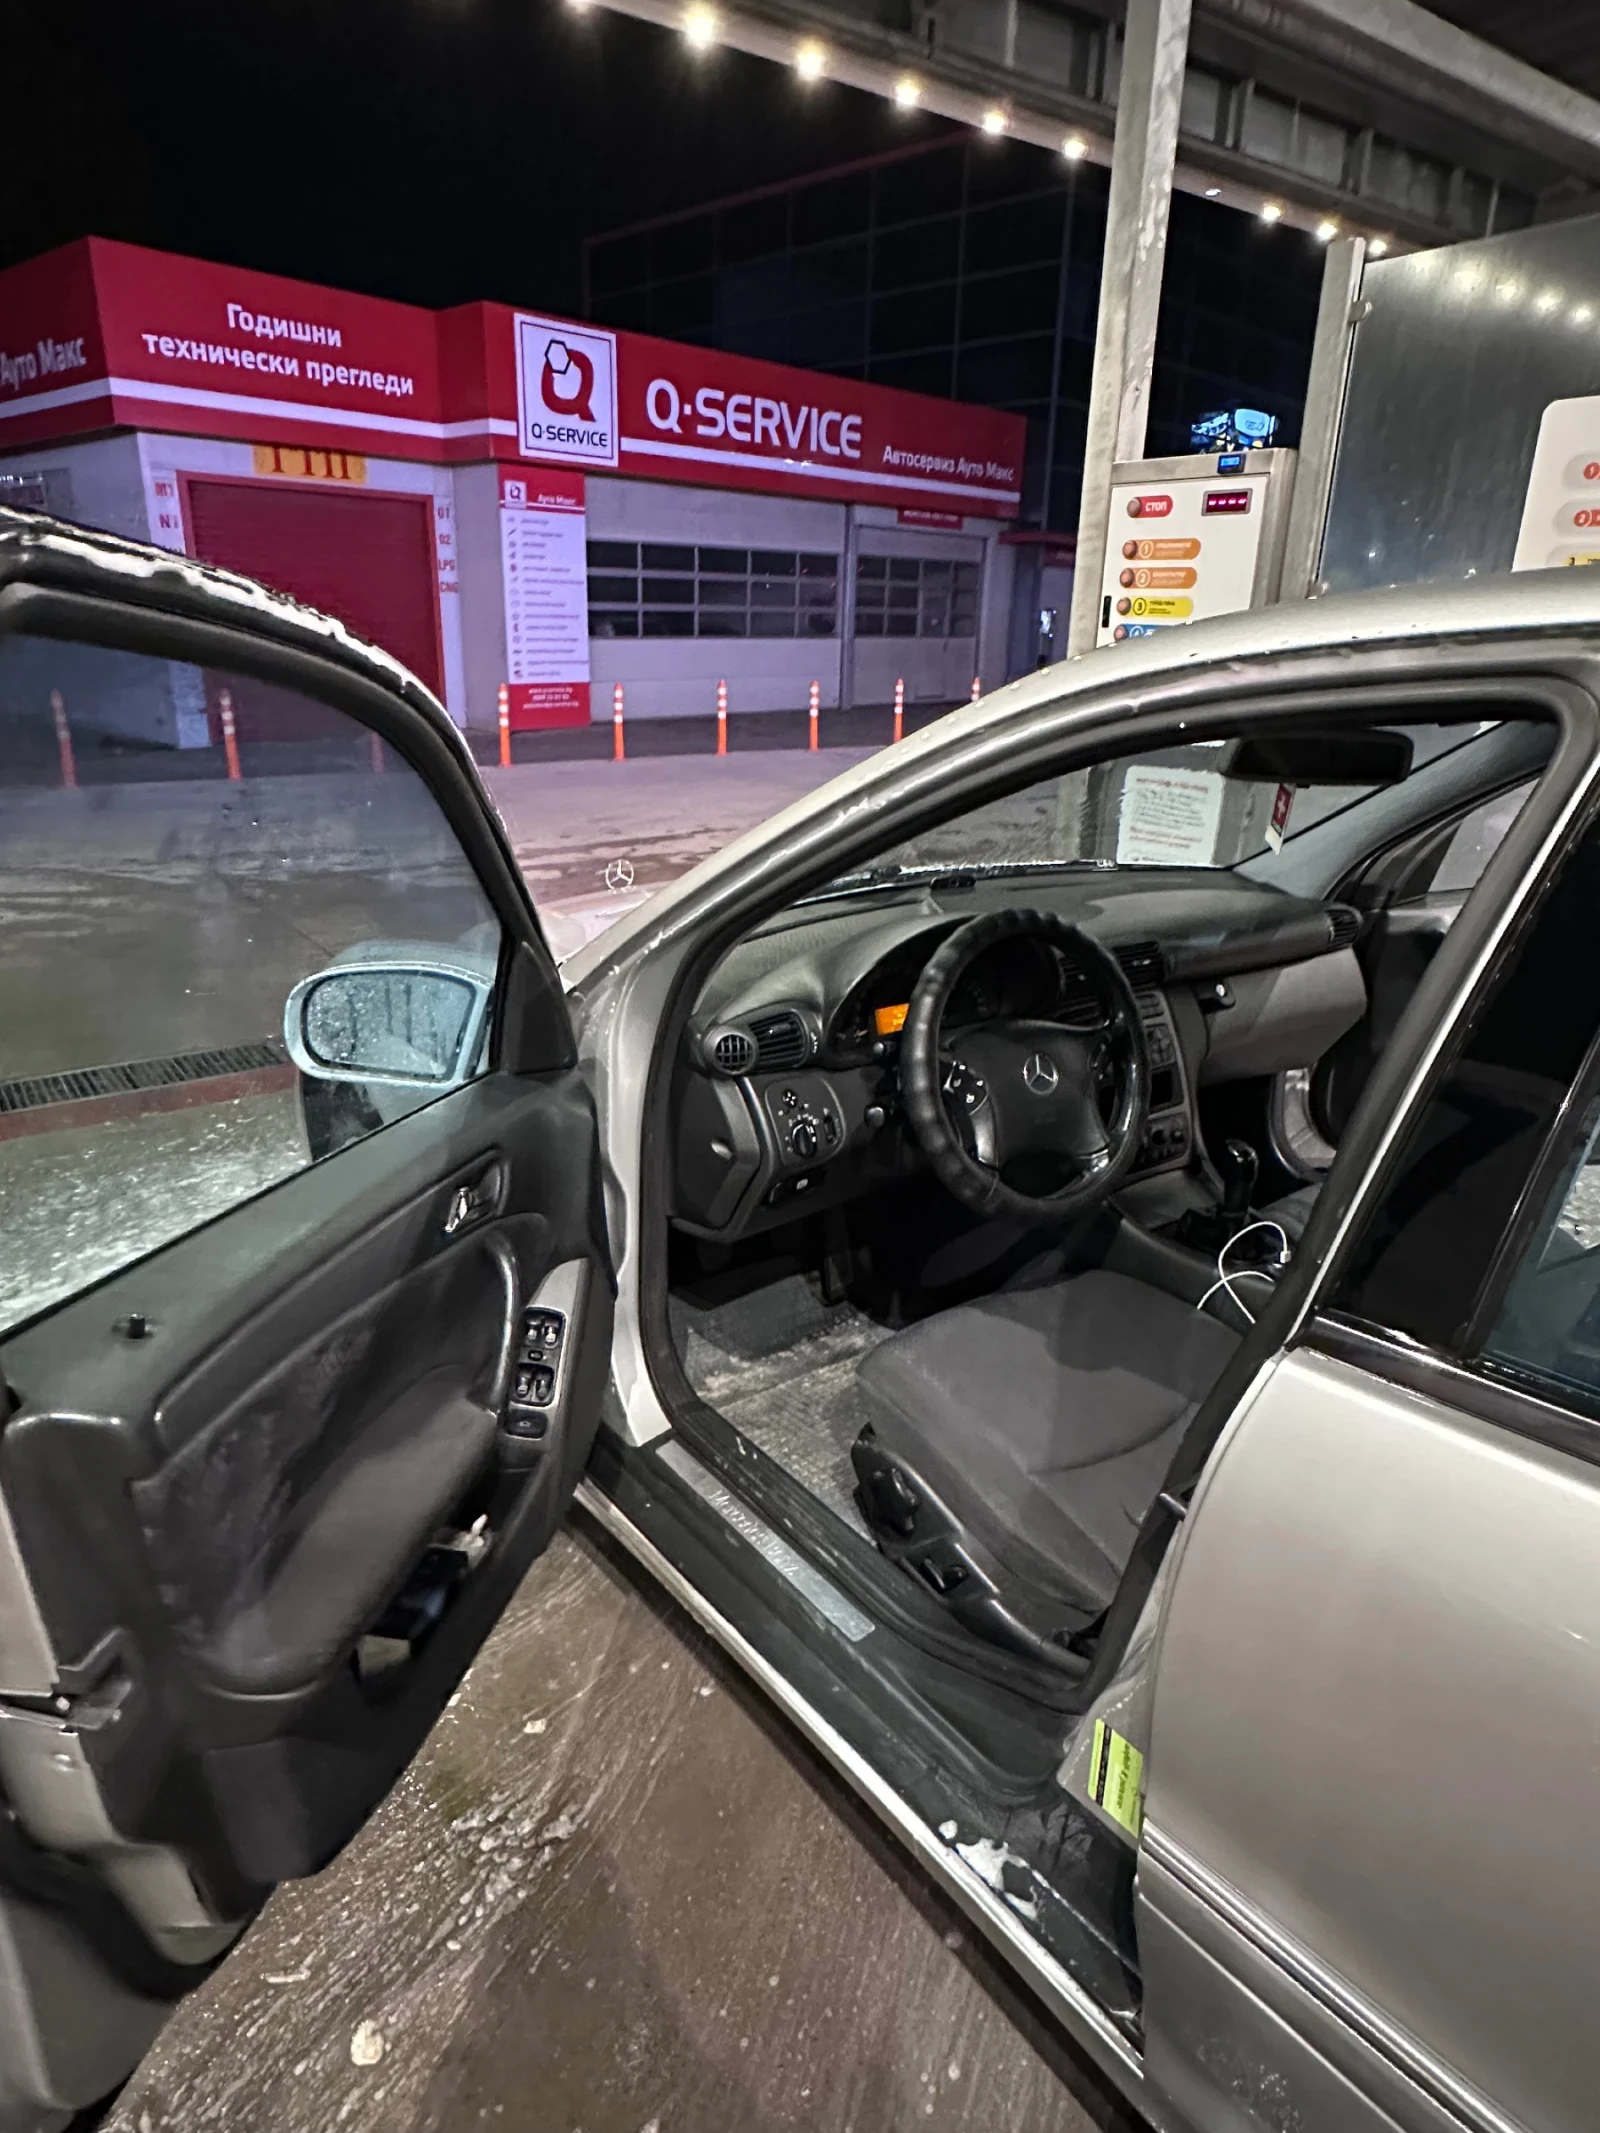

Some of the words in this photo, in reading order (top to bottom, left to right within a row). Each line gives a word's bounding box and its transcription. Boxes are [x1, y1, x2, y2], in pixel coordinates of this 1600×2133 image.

[226, 303, 342, 347] Годишни
[37, 337, 87, 376] Макс
[141, 333, 300, 376] технически
[305, 360, 414, 397] прегледи
[883, 445, 955, 473] Автосервиз
[956, 457, 983, 479] Ауто
[985, 461, 1015, 482] Макс
[1145, 501, 1167, 512] СТОП
